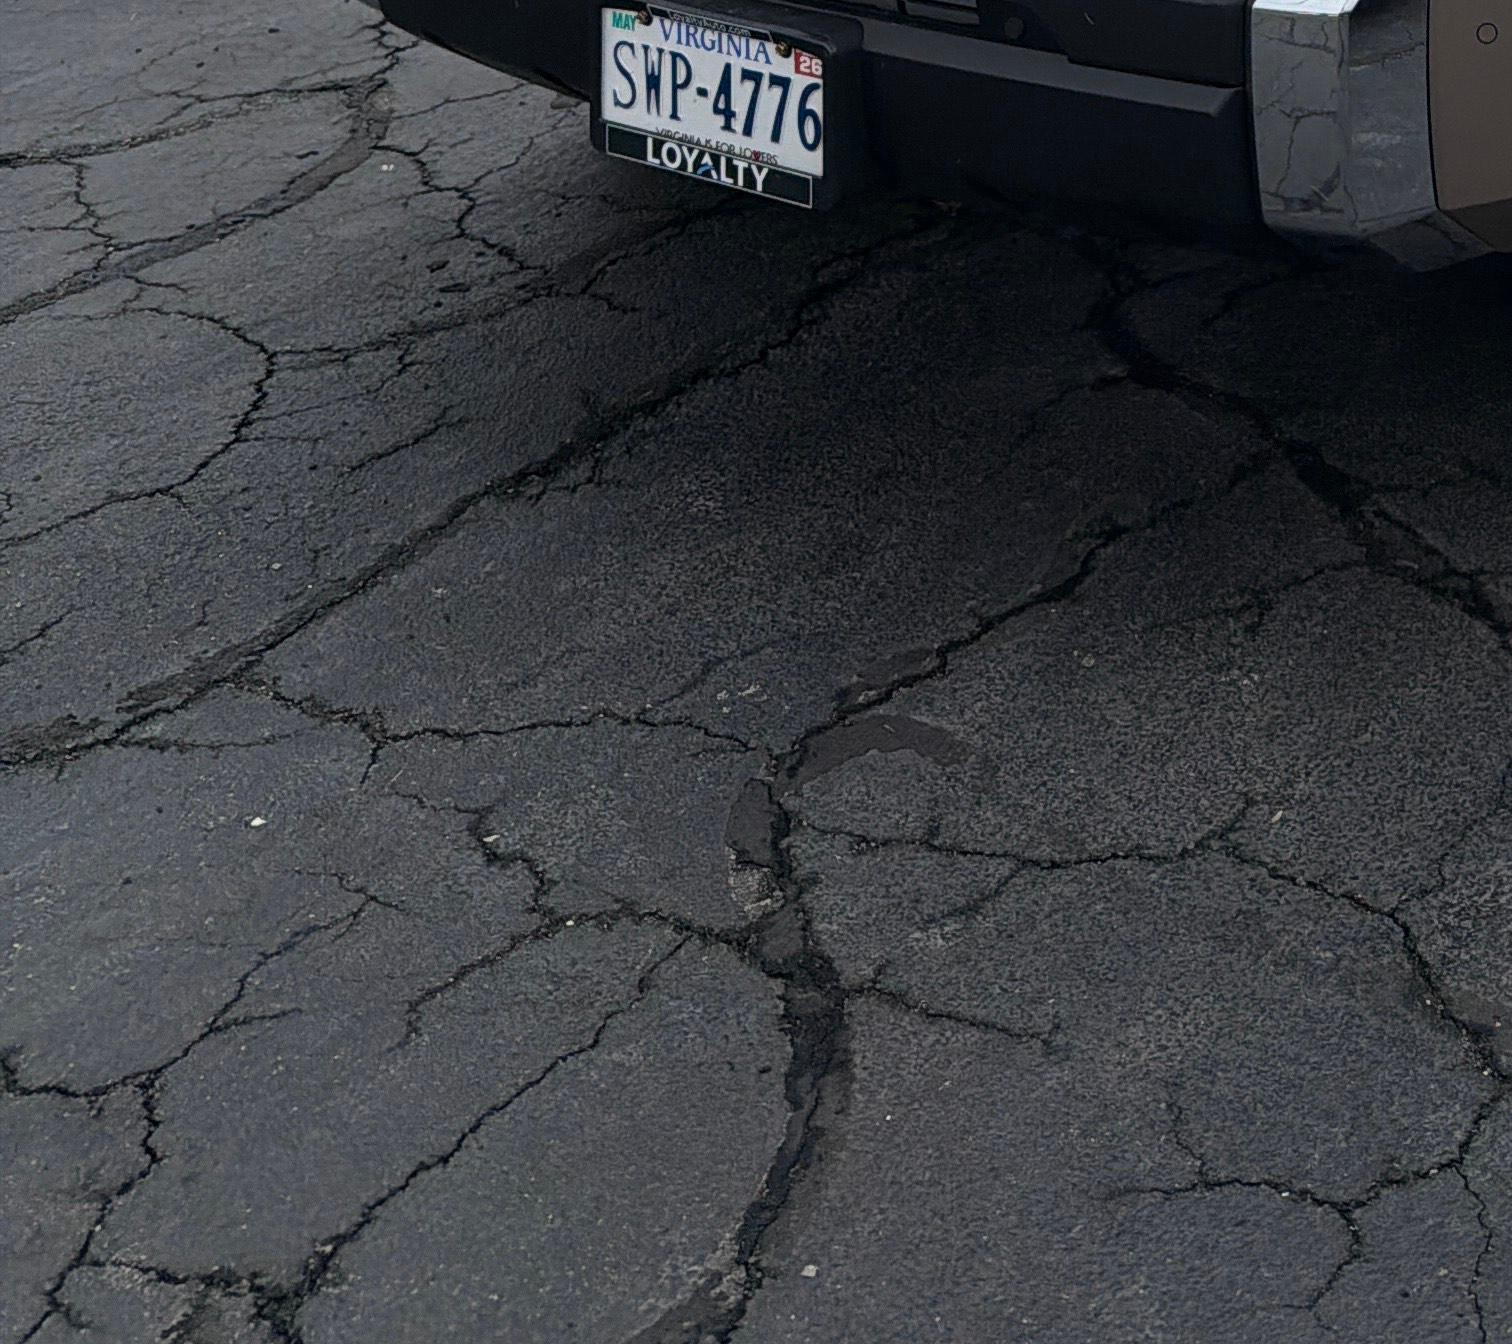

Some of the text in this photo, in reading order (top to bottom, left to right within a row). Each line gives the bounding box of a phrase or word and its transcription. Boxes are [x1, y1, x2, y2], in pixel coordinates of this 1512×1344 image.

[612, 12, 637, 32] MAY
[659, 18, 773, 65] VIRGINIA
[799, 54, 823, 75] 26
[612, 40, 823, 153] SWP-4776
[655, 127, 702, 145] VIRGINIA
[715, 141, 736, 155] FOR
[646, 136, 769, 192] LOYALTY
